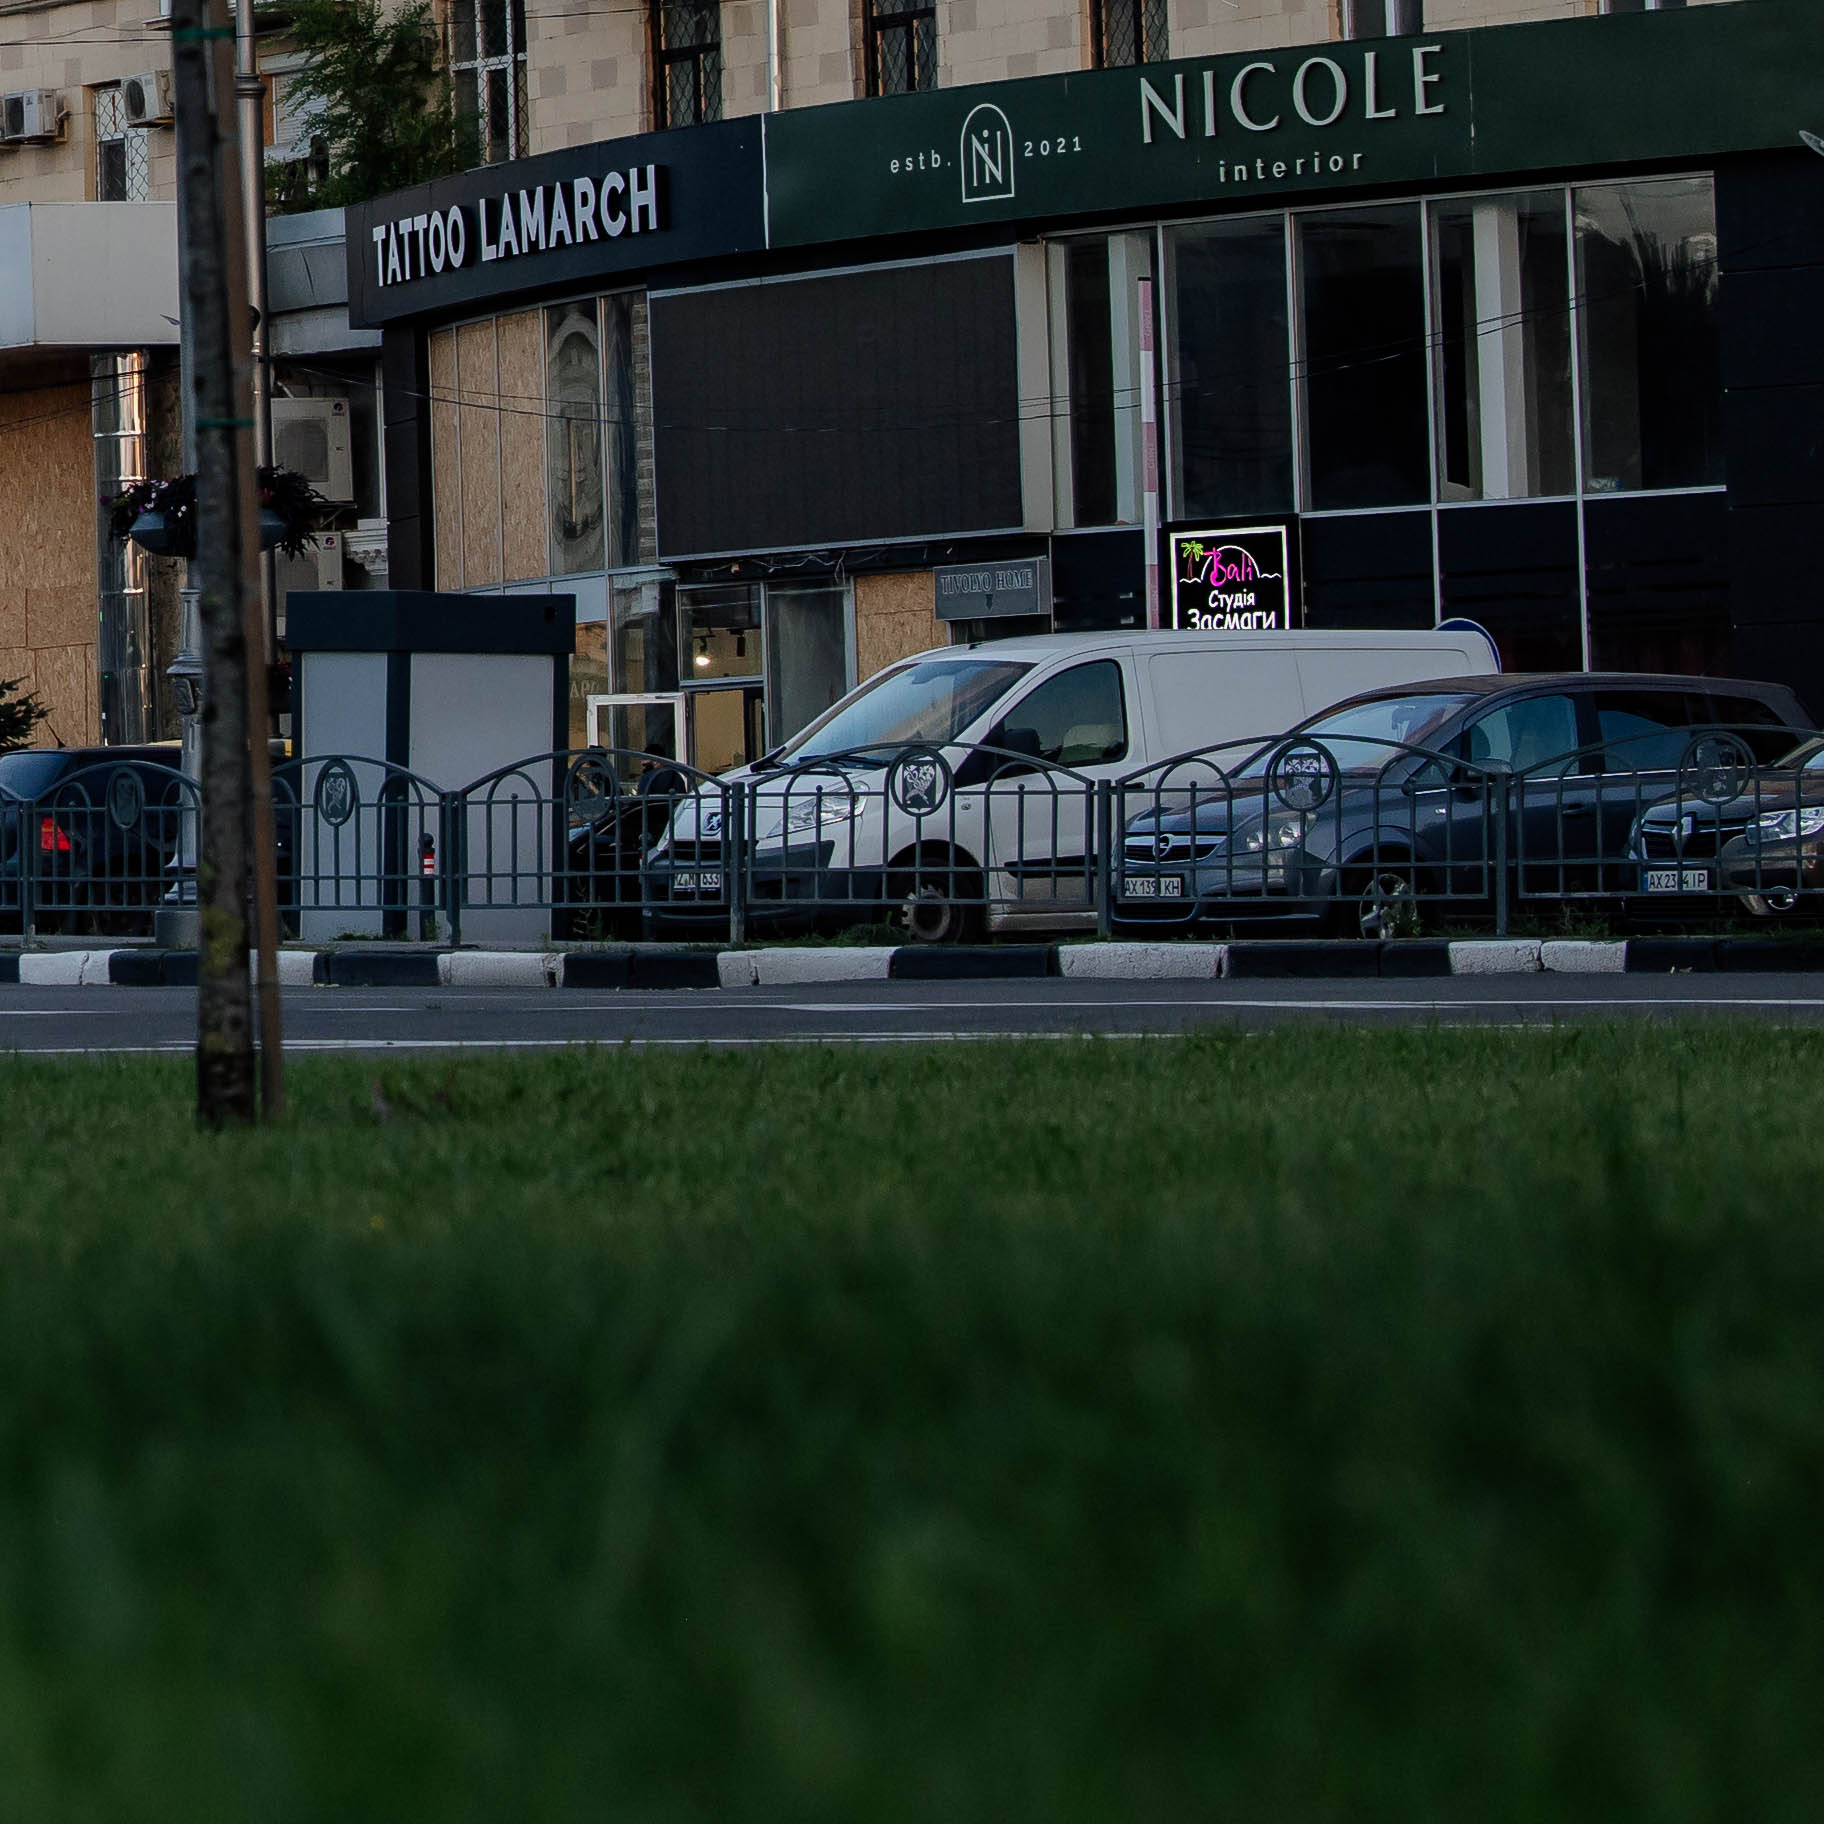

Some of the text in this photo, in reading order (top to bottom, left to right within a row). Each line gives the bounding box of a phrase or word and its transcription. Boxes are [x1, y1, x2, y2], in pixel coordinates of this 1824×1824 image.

[1140, 45, 1445, 144] NICOLE
[890, 149, 951, 173] estb.
[1024, 136, 1082, 157] 2021
[1219, 152, 1363, 182] interior
[373, 164, 658, 287] TATTOO LAMARCH
[995, 569, 1032, 591] HOME
[1203, 547, 1253, 587] Bali
[1208, 588, 1256, 613] Студія
[1187, 608, 1276, 630] Засмаги
[1664, 873, 1690, 889] 234
